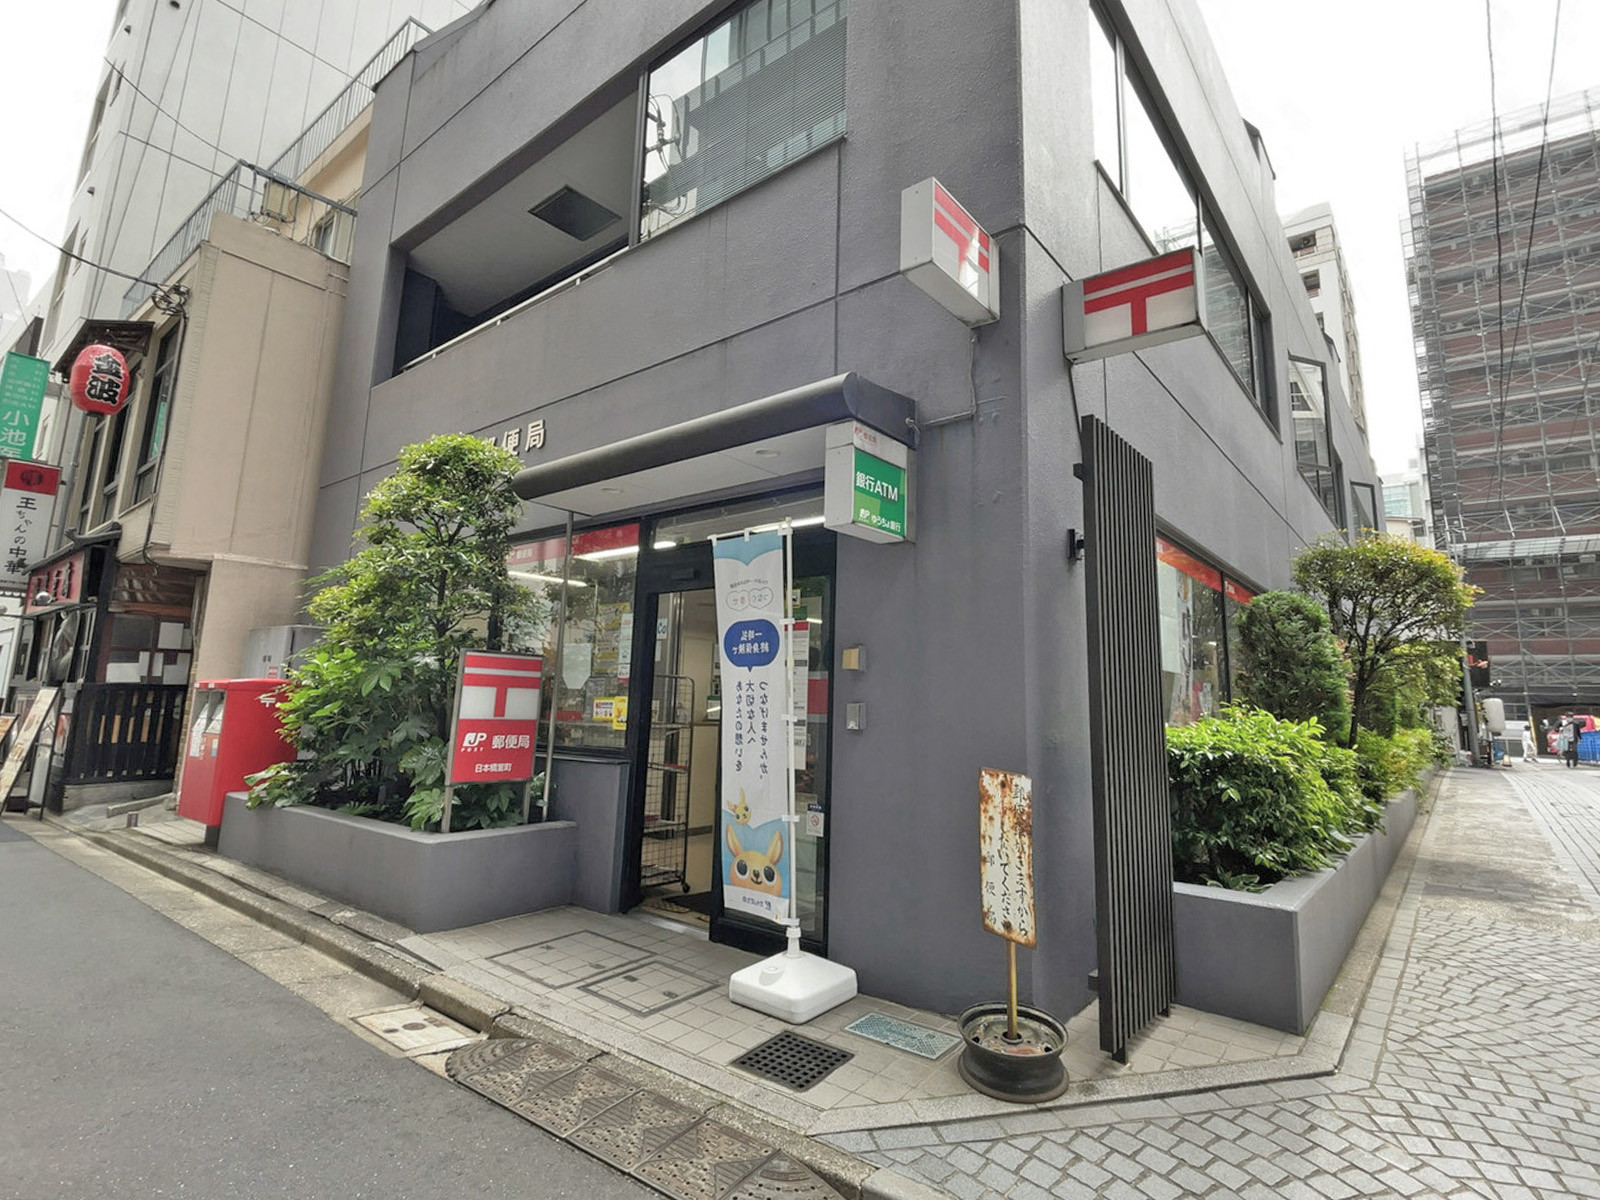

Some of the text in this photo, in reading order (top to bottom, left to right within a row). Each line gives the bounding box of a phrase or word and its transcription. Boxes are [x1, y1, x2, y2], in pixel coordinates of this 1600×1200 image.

[488, 419, 547, 456] 便局
[855, 471, 899, 501] 銀行ATM
[871, 514, 901, 533] ゆうちょ銀行
[491, 734, 530, 749] 郵便局
